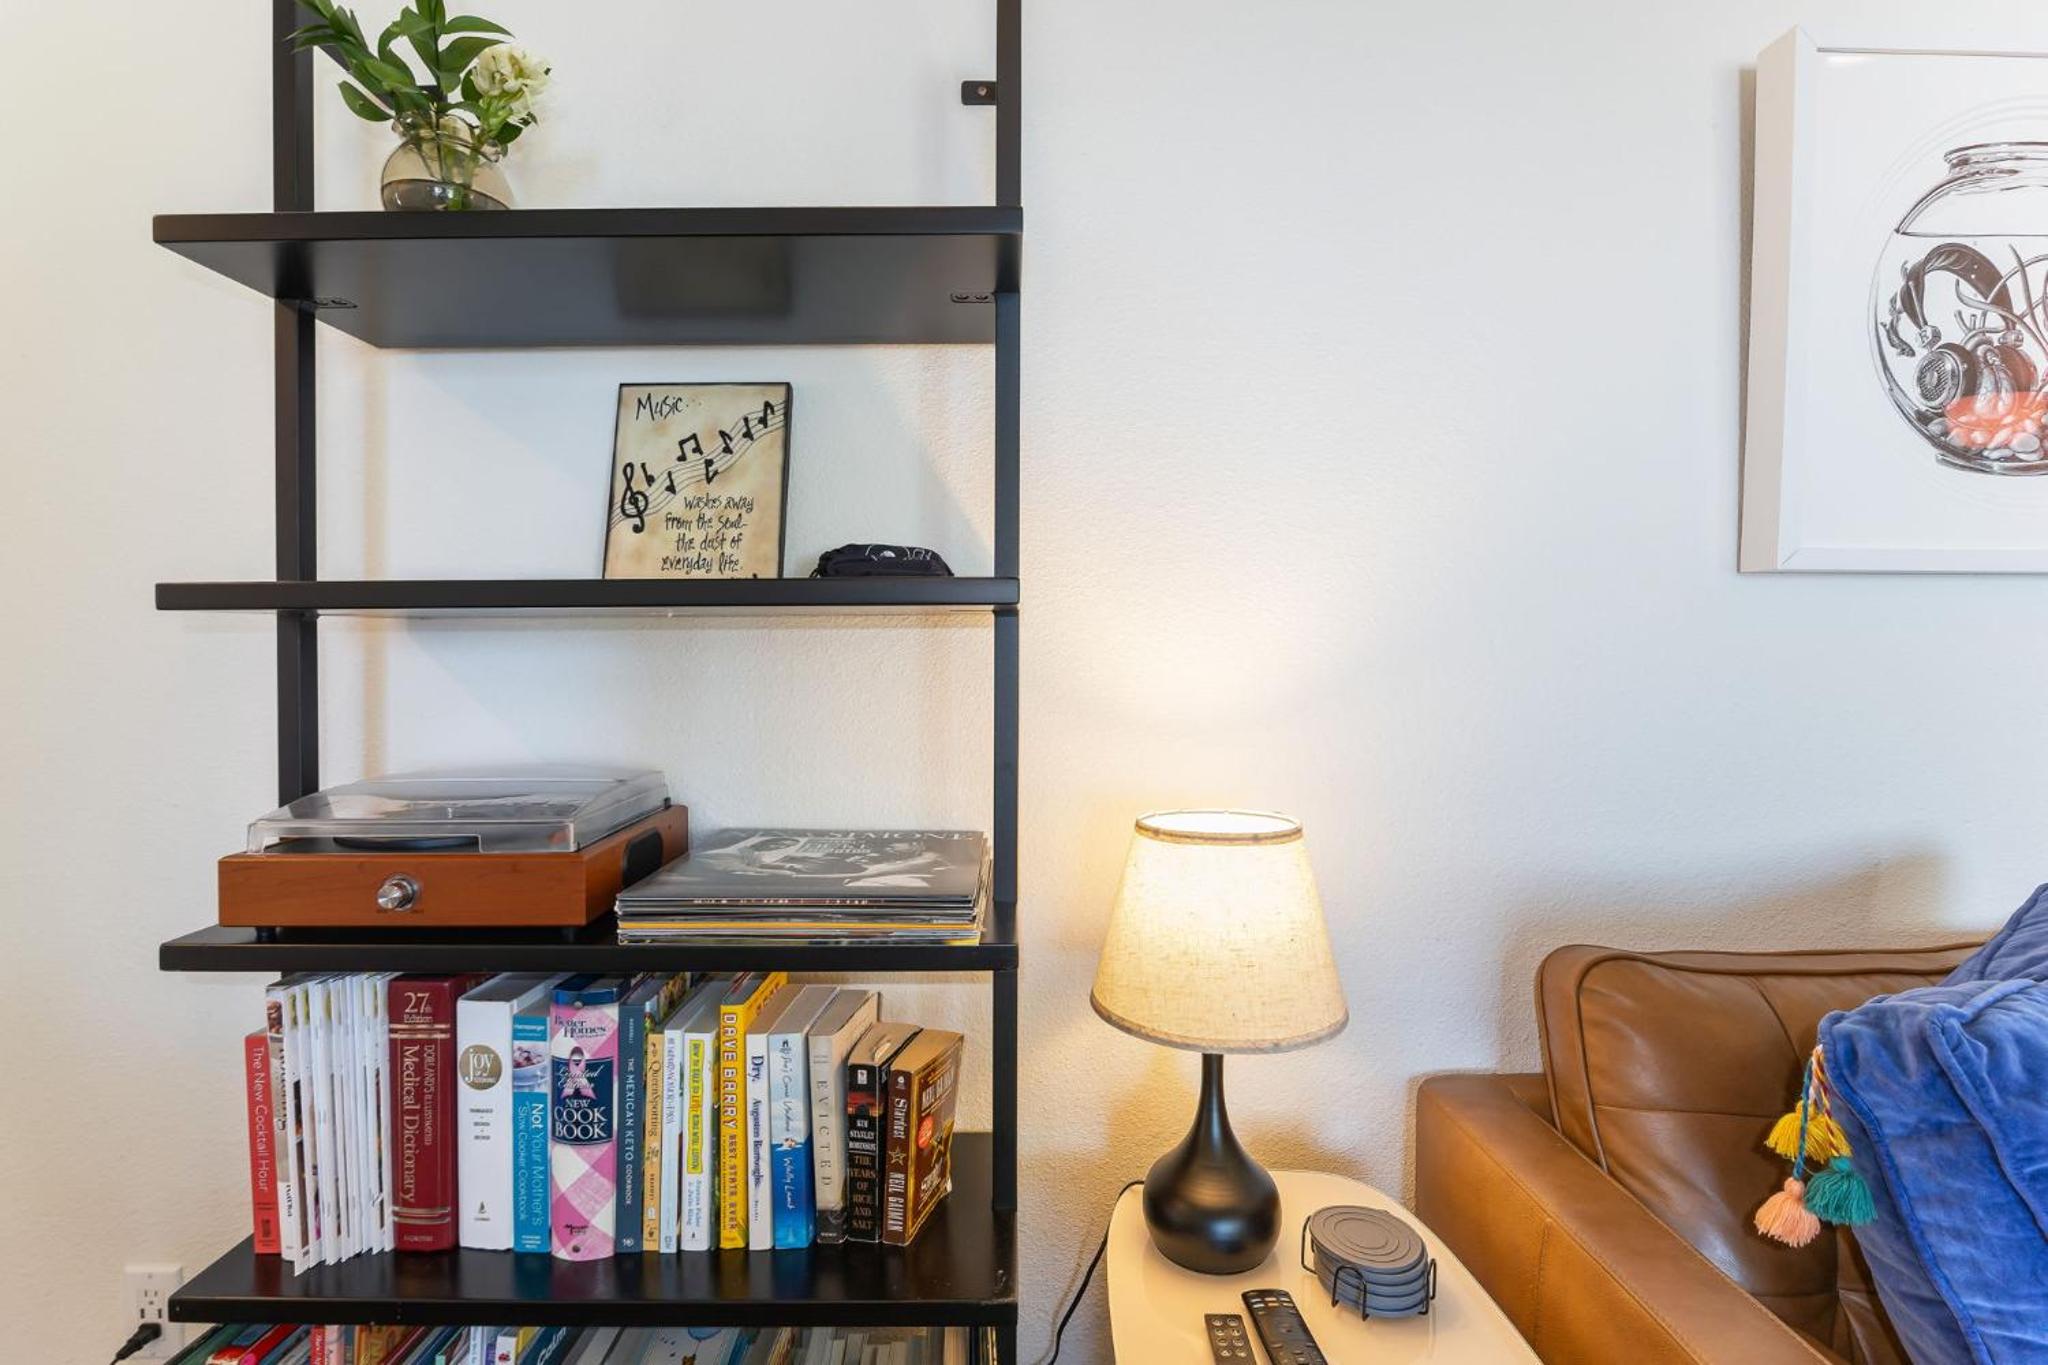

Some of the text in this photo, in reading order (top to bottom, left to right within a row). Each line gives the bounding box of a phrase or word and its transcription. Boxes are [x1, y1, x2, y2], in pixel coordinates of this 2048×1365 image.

[725, 496, 754, 513] away
[665, 512, 693, 531] from
[697, 513, 713, 531] the
[676, 532, 743, 552] the dust of
[661, 551, 713, 574] everyday
[563, 1025, 606, 1038] Homes
[464, 1048, 494, 1084] joy
[722, 1012, 737, 1128] DAVE BARRY
[531, 1103, 545, 1128] Not
[554, 1107, 607, 1124] COOK
[565, 1099, 591, 1108] NEW
[252, 1046, 270, 1192] The New Cocktail Hour
[400, 1044, 420, 1203] Medical Dictionary
[750, 1098, 763, 1138] Augusten
[555, 1123, 607, 1140] BOOK
[624, 1058, 635, 1205] THE MEXICAN KETO COOKBOOK
[816, 1080, 833, 1187] EVICTED
[531, 1132, 545, 1162] Your
[727, 1134, 737, 1159] BEST
[517, 1106, 528, 1221] Slow Cooker Cookbook
[782, 1156, 793, 1183] Wally
[854, 1155, 872, 1166] THE
[887, 1098, 908, 1232] Stardust NEIL GAIMAN
[849, 1169, 876, 1179] YEARS
[856, 1181, 869, 1190] OF
[531, 1165, 546, 1226] Mother's
[853, 1206, 872, 1217] AND
